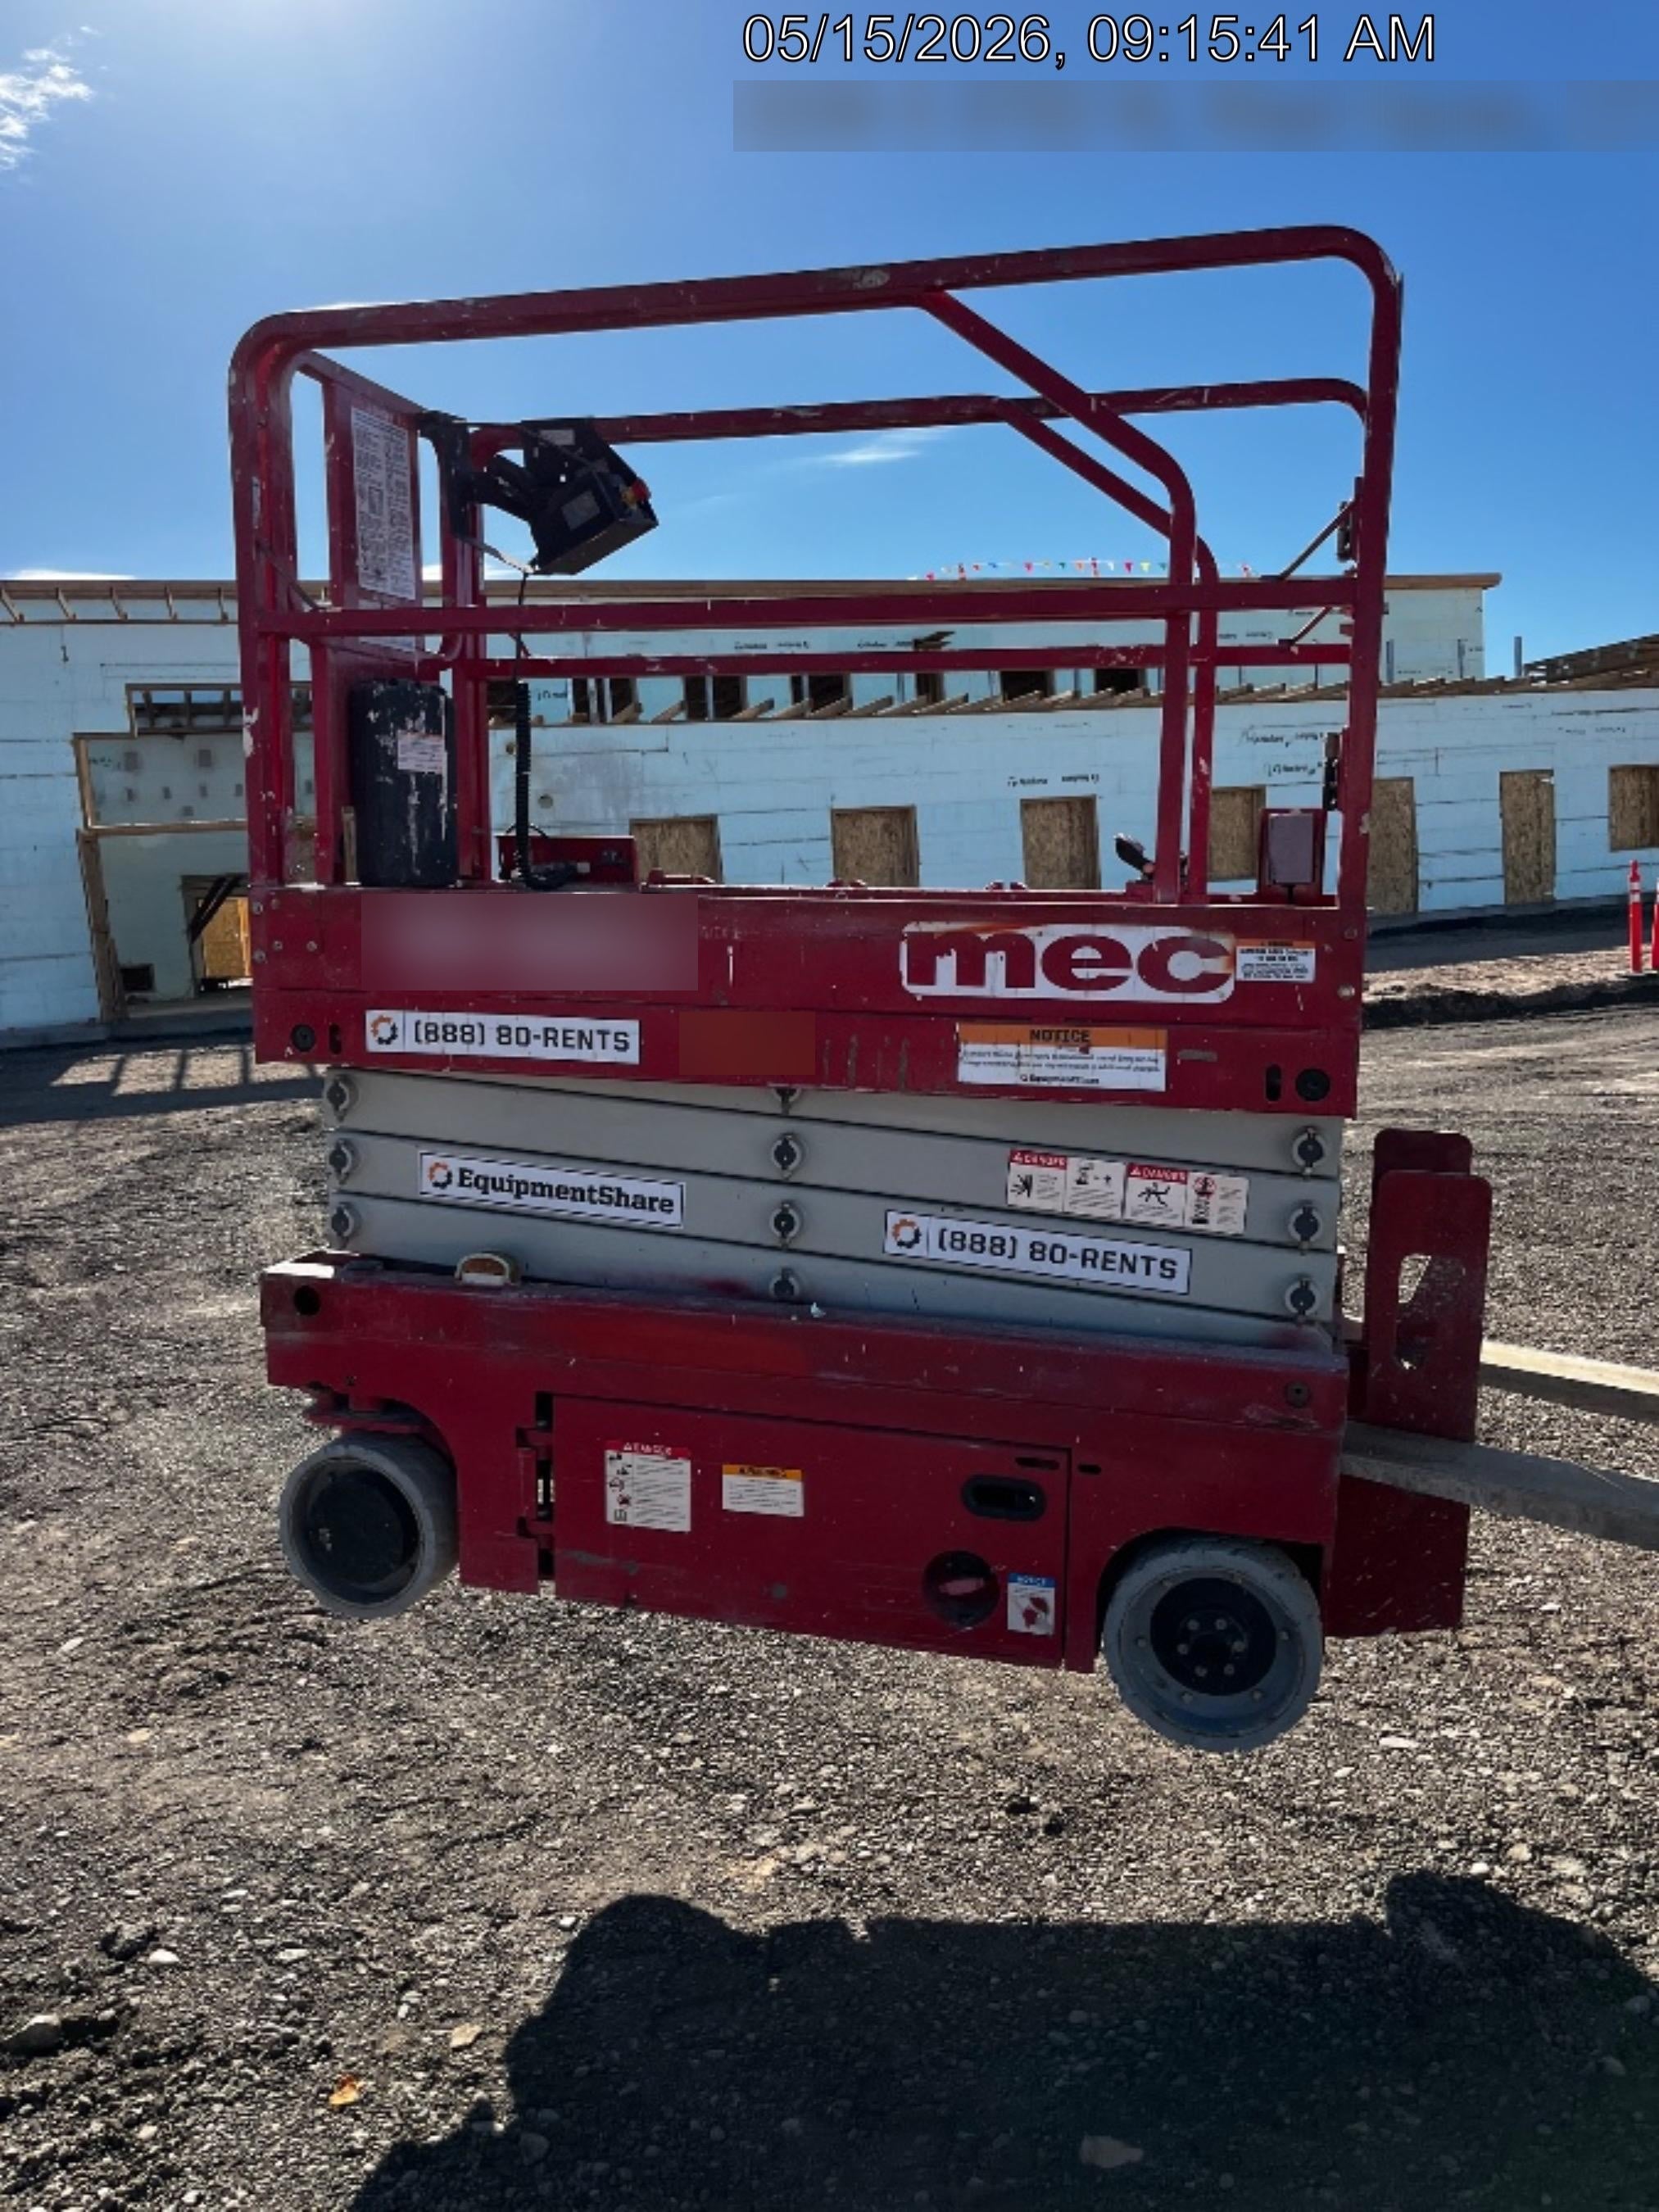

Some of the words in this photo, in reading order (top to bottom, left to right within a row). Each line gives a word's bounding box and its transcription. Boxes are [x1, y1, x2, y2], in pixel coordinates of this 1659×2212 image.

[907, 932, 1231, 993] mec
[414, 1019, 485, 1046] (888)
[496, 1025, 630, 1052] 80-RENTS
[1029, 1028, 1090, 1044] NOTICE
[457, 1167, 674, 1213] EquipmentShare
[938, 1228, 1018, 1259] (888)
[1029, 1240, 1177, 1279] 80-RENTS
